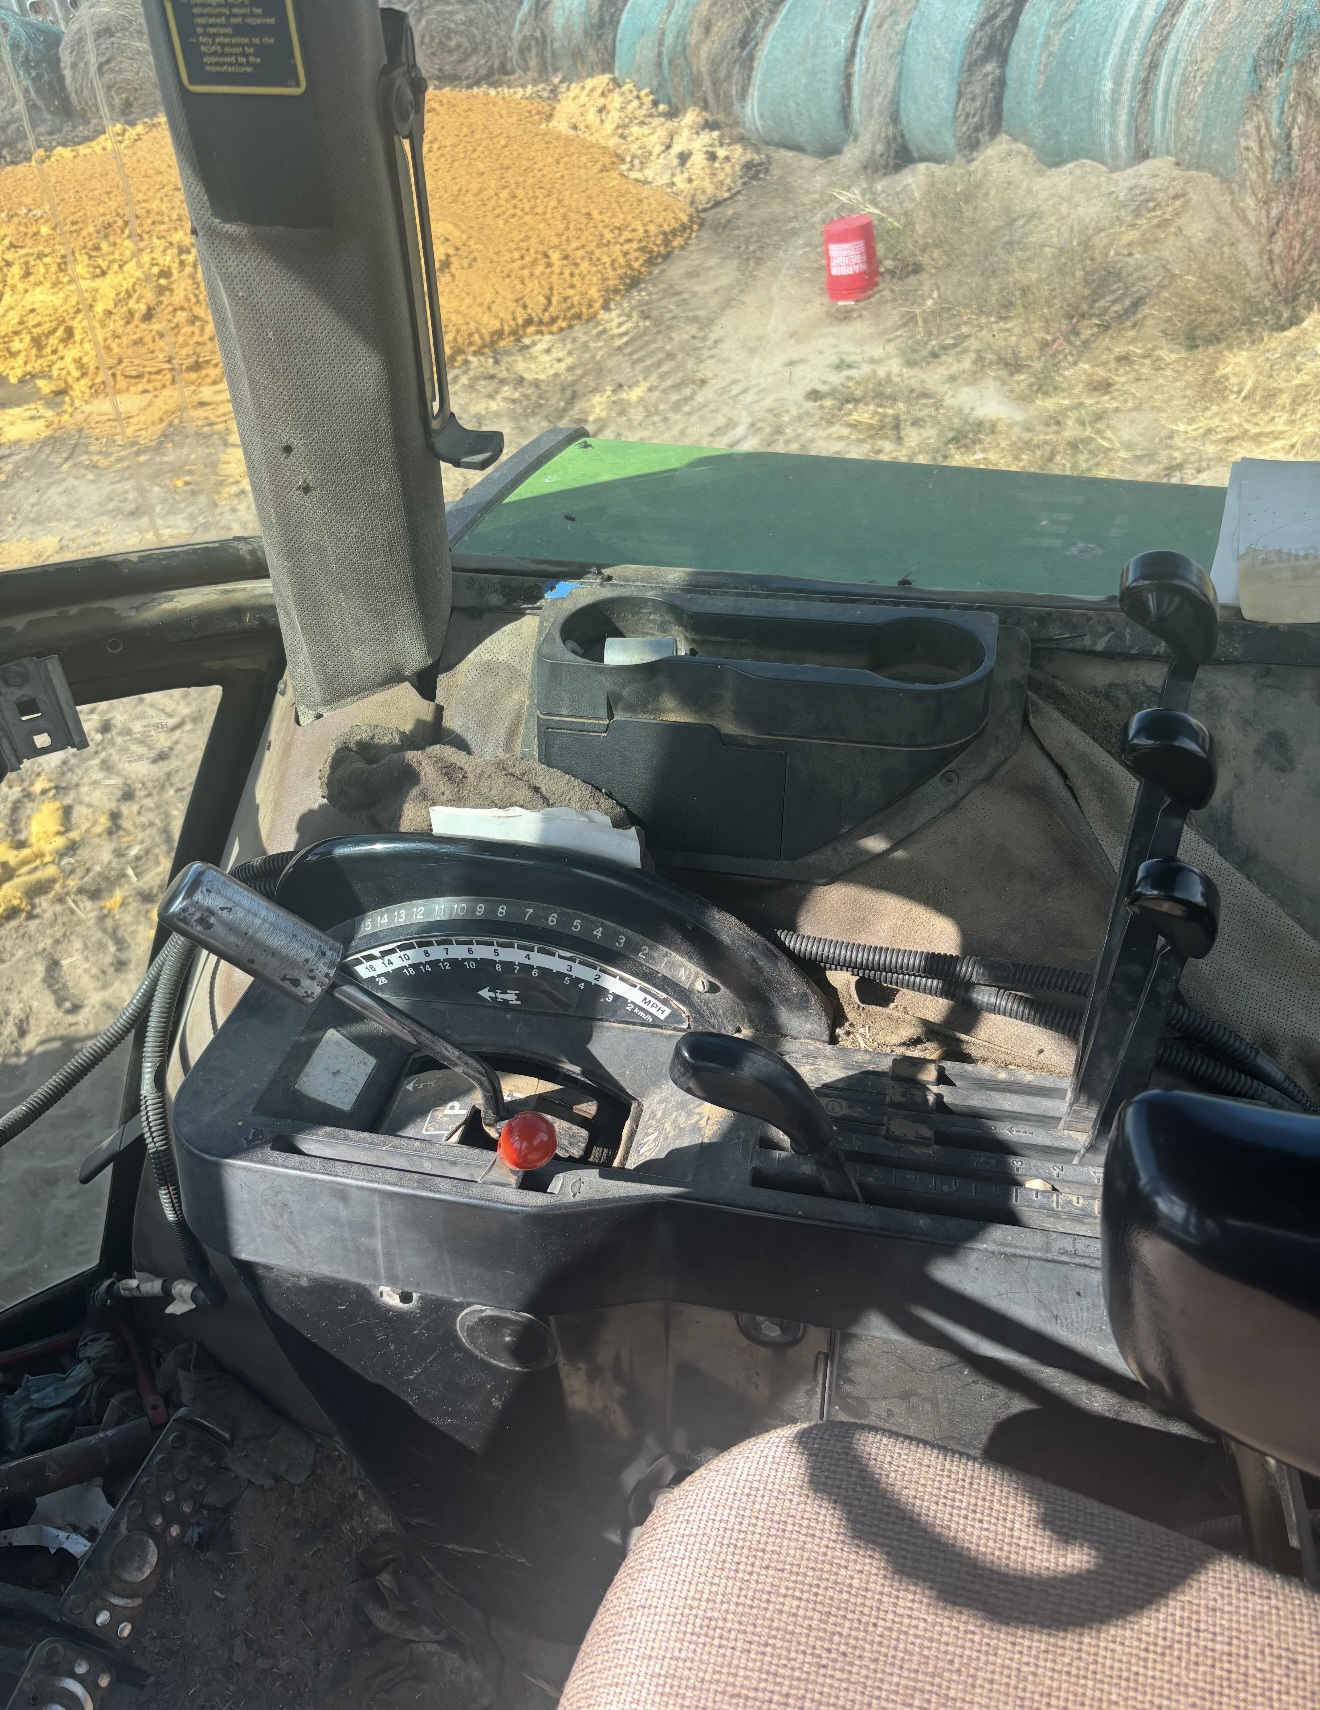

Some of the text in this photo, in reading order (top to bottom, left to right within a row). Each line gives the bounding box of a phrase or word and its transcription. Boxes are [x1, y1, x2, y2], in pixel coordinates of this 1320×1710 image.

[377, 913, 388, 927] 14
[394, 910, 406, 923] 13
[412, 906, 425, 920] 12
[434, 904, 445, 917] 11
[453, 903, 467, 916] 10
[476, 903, 485, 916] 9
[498, 905, 507, 917] 8
[524, 908, 534, 921] 7
[548, 913, 558, 926] 6
[571, 919, 581, 932] 5
[593, 926, 603, 939] 4
[616, 935, 626, 948] 3
[638, 945, 649, 958] 2
[365, 947, 666, 1015] 18 14 10 8 7 6 5 4 3 2 MPH
[403, 968, 416, 976] 18
[419, 964, 432, 973] 14
[438, 962, 451, 970] 12
[464, 961, 476, 970] 10
[495, 964, 502, 972] 8
[514, 965, 520, 974] 7
[531, 968, 539, 978] 6
[563, 976, 570, 985] 5
[578, 982, 585, 990] 4
[605, 994, 613, 1003] 3
[625, 1003, 634, 1012] 2
[634, 1007, 653, 1023] km/h
[443, 1101, 468, 1115] P
[1012, 1159, 1023, 1167] 3
[1052, 1164, 1064, 1173] 2
